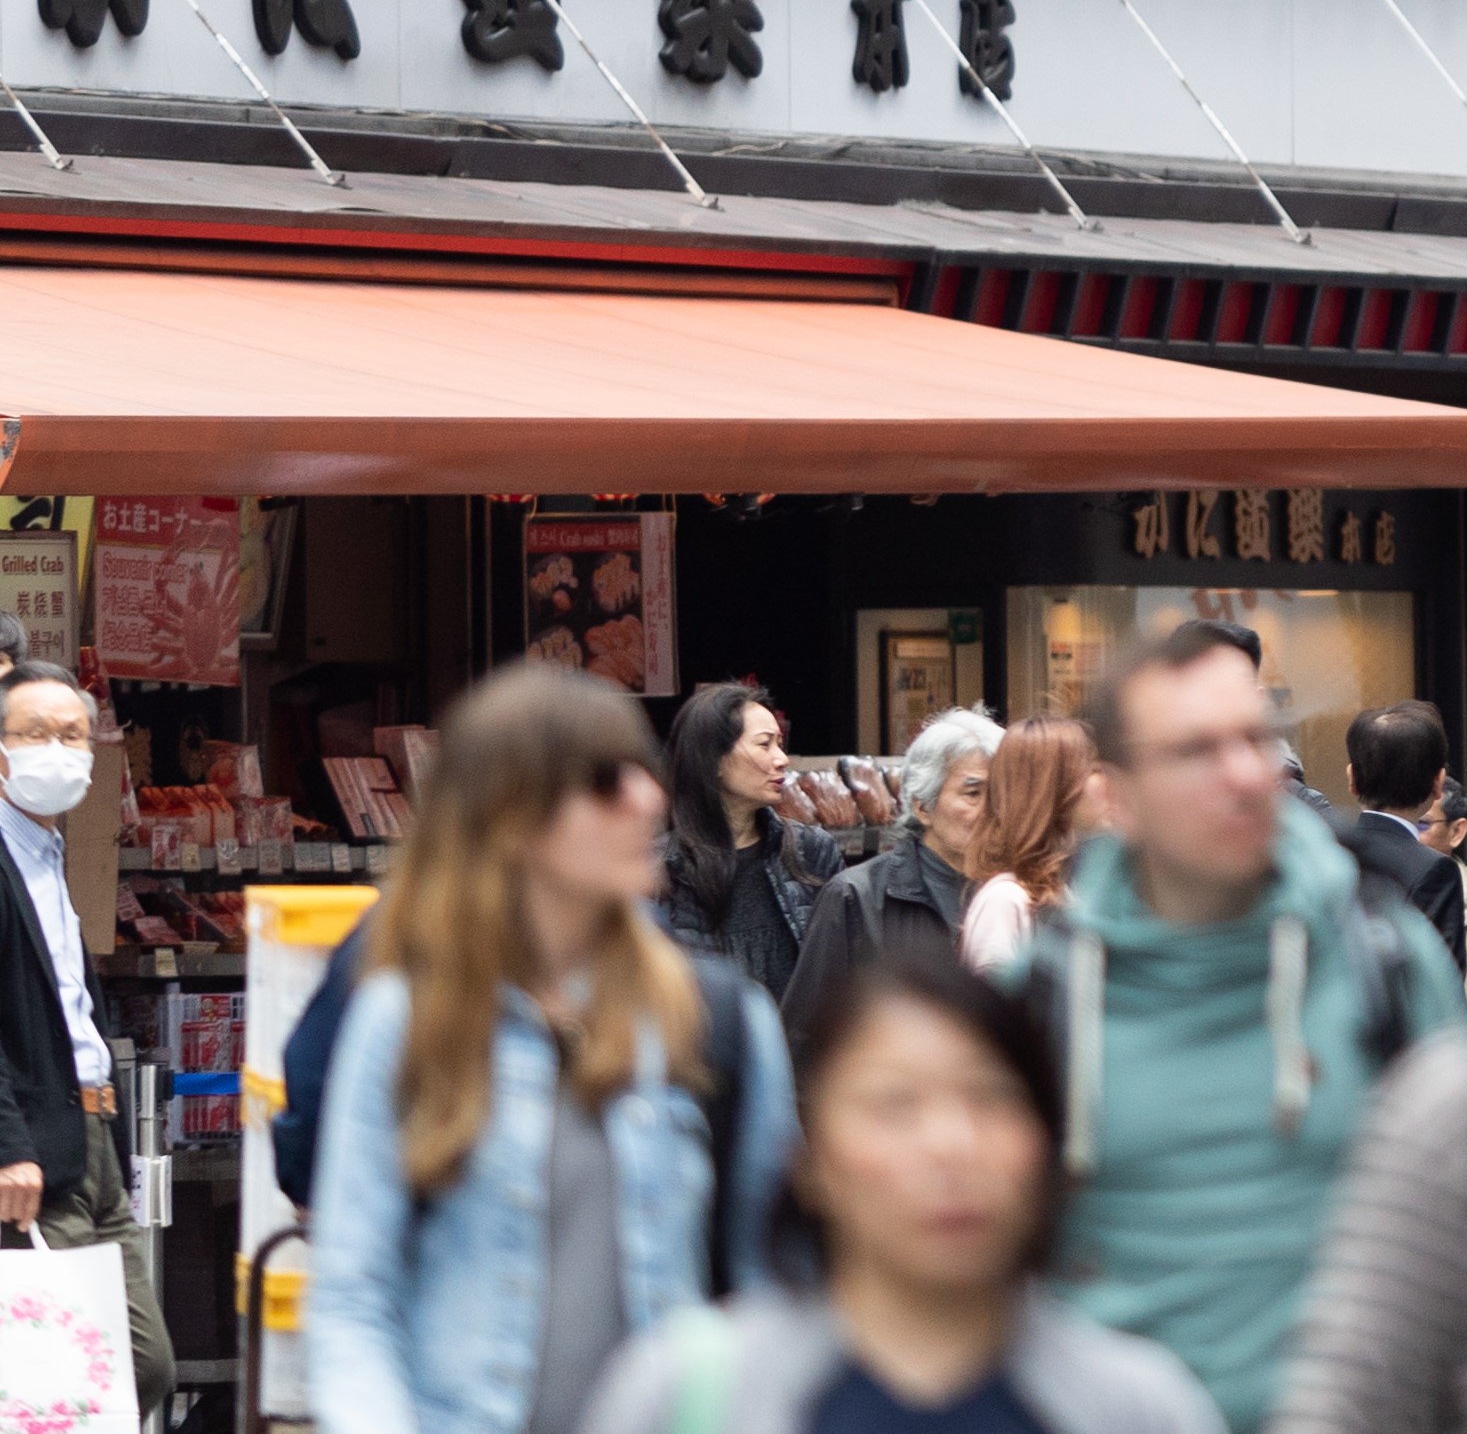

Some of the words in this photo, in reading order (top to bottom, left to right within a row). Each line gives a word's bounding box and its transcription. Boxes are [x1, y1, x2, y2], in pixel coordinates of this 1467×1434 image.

[102, 500, 203, 534] お土産コーナー
[1, 554, 38, 575] Grilled
[40, 555, 64, 575] Crab
